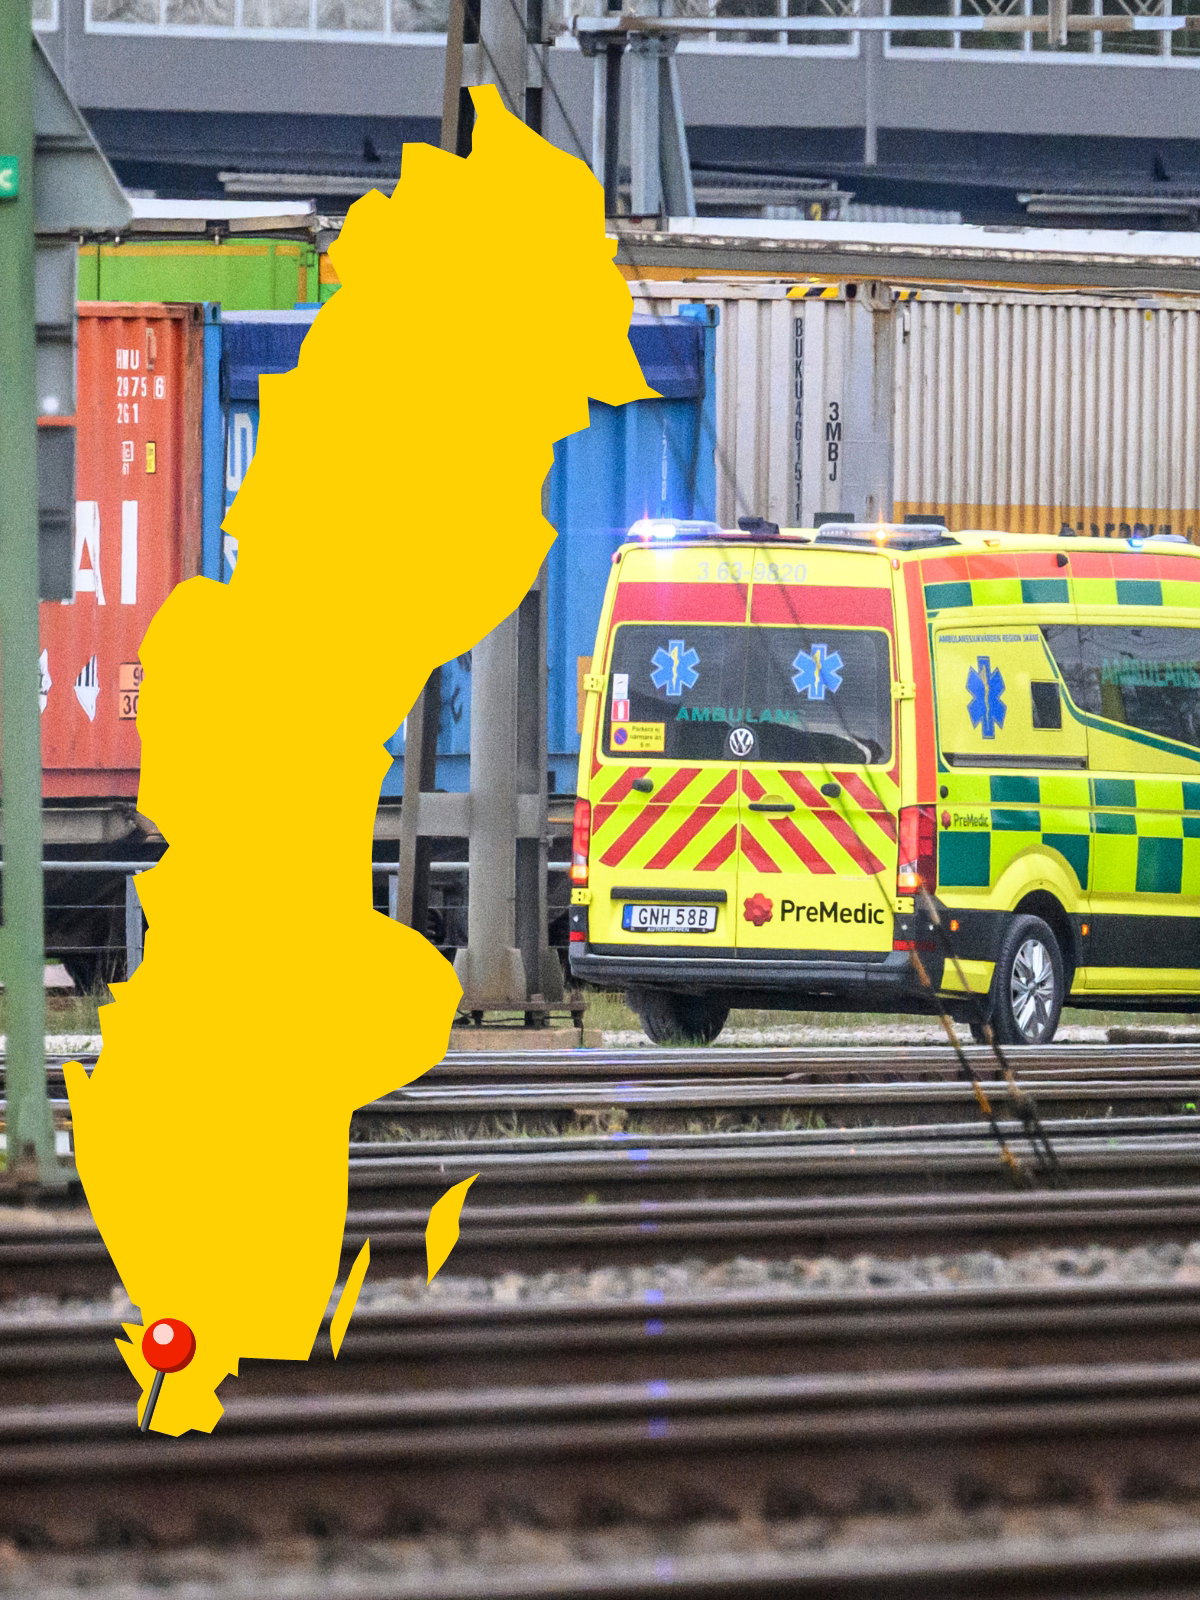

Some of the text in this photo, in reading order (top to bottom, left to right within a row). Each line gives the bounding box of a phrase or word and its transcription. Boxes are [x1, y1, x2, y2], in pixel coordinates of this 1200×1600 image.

[953, 813, 989, 828] PreMedic
[638, 908, 709, 927] GNH 58B
[780, 900, 885, 925] PreMedic
